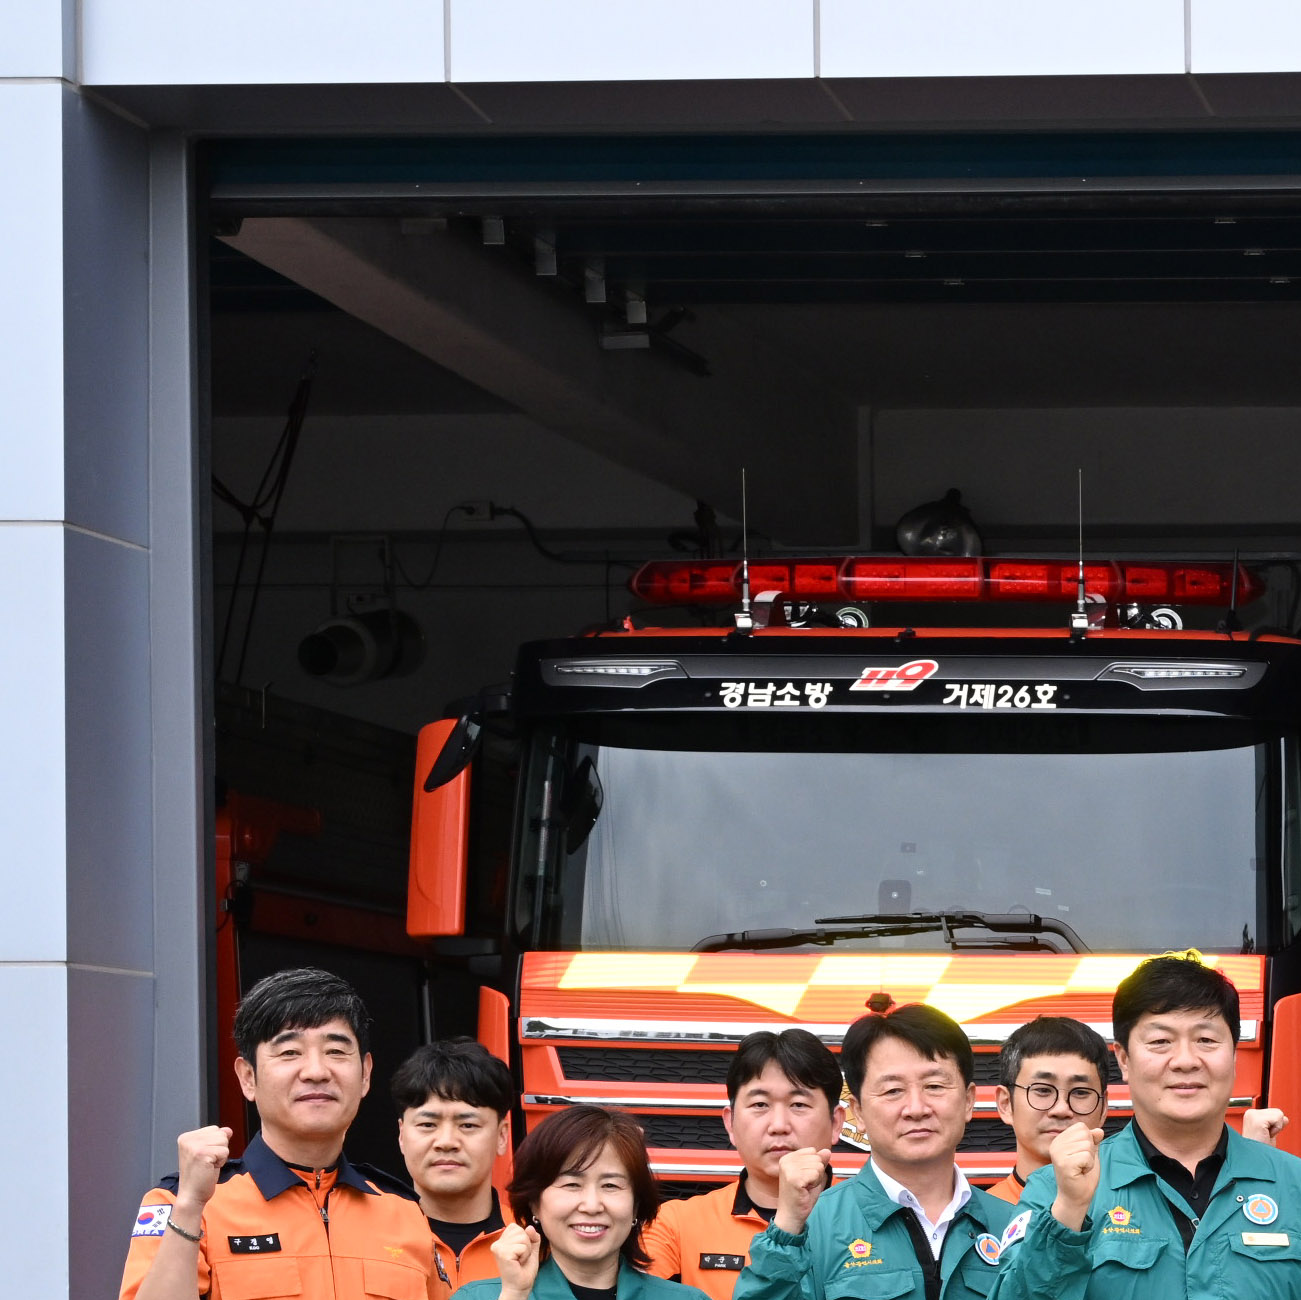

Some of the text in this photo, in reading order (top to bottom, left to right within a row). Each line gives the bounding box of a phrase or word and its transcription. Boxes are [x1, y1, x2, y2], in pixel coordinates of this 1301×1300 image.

[853, 660, 938, 690] 119
[719, 682, 833, 708] 경남소방
[943, 684, 1058, 709] 거제26호
